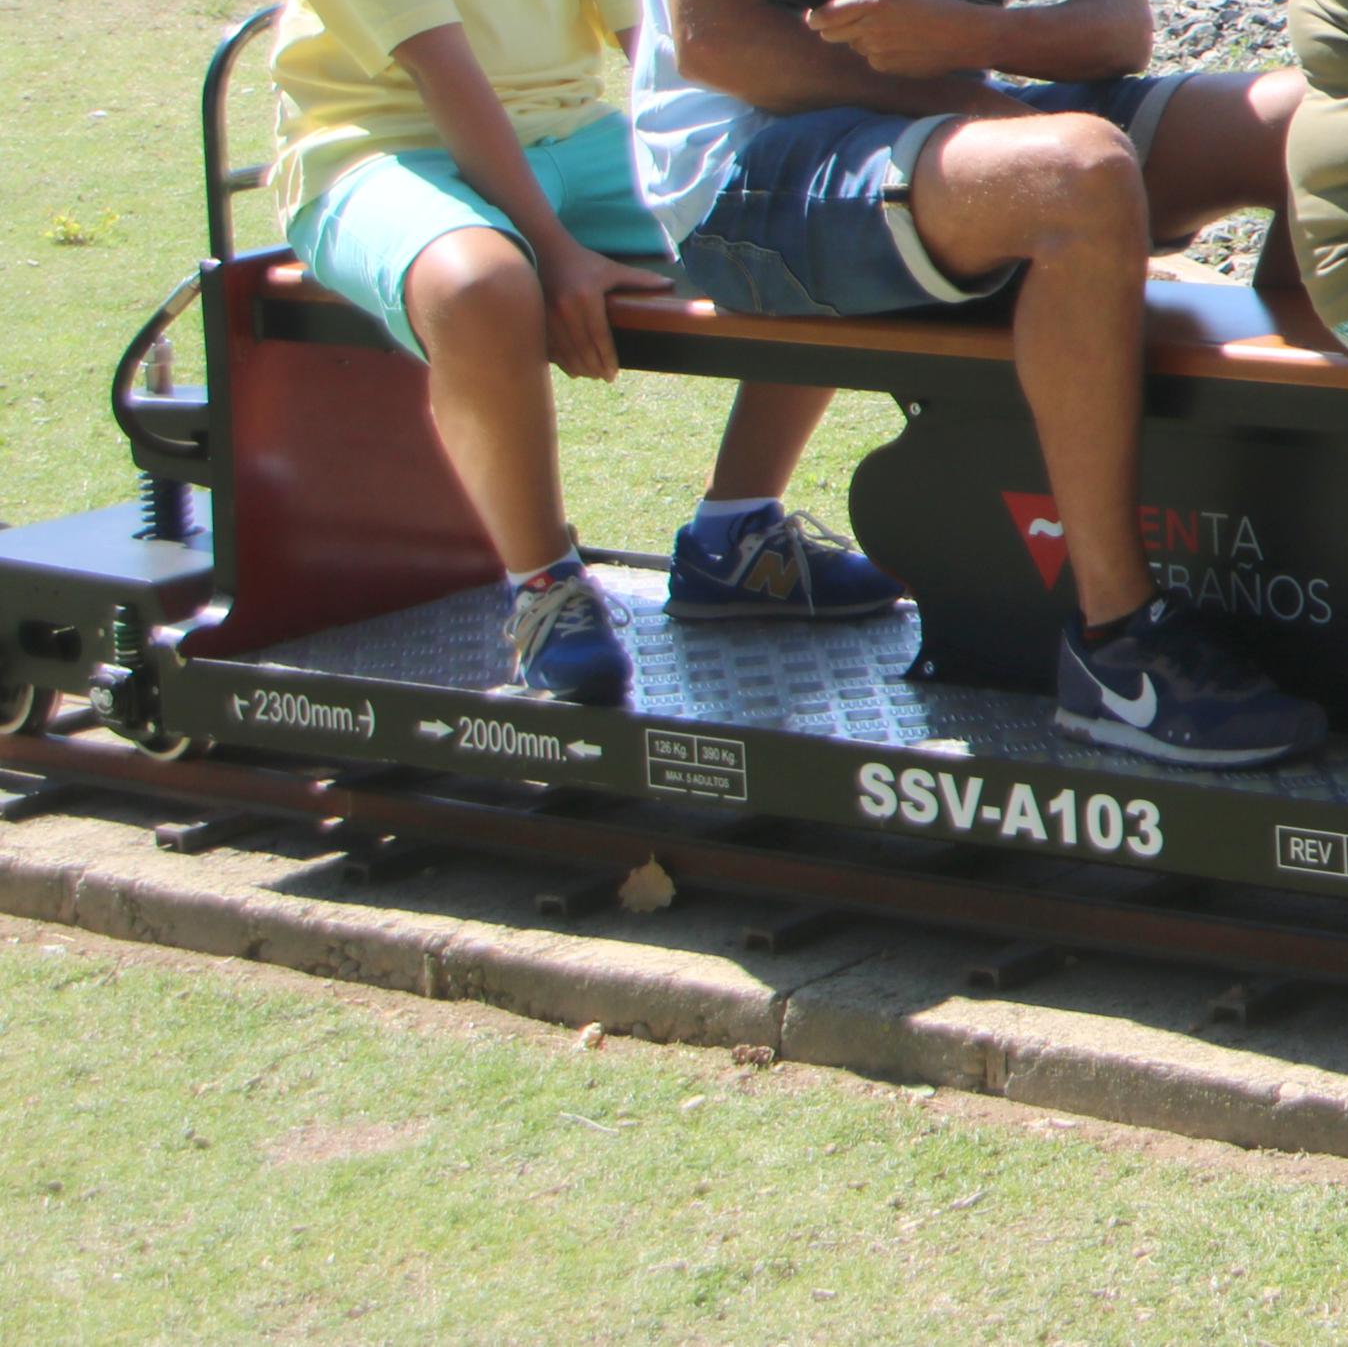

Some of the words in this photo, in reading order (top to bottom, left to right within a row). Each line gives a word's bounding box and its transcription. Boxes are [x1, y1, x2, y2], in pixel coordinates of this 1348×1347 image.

[1138, 504, 1264, 561] ENTA
[459, 715, 568, 762] 2000mm.
[692, 773, 730, 789] ADULTOS
[859, 762, 1164, 857] SSV-A103
[1289, 836, 1333, 866] REV
